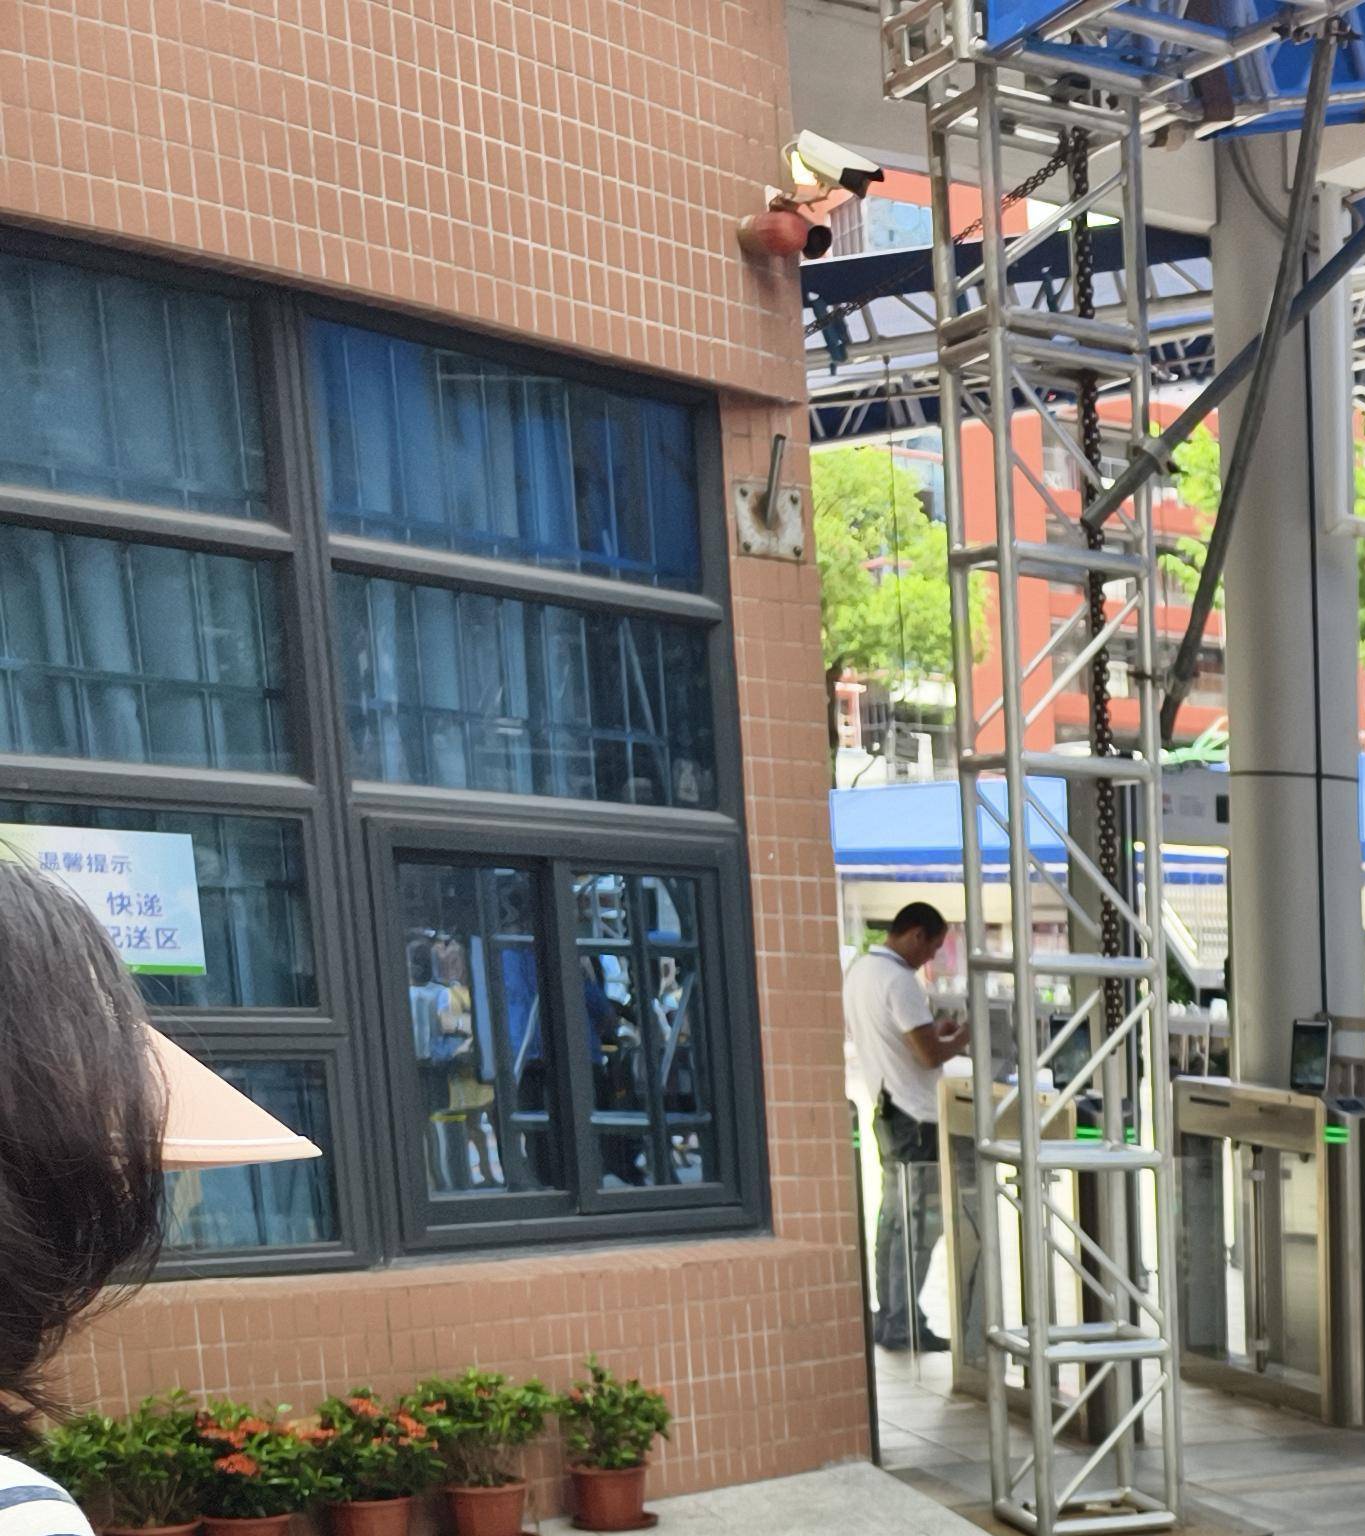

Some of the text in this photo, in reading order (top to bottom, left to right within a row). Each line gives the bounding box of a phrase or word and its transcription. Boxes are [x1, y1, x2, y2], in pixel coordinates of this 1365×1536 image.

[39, 851, 134, 876] 温馨提示
[106, 890, 164, 918] 快递
